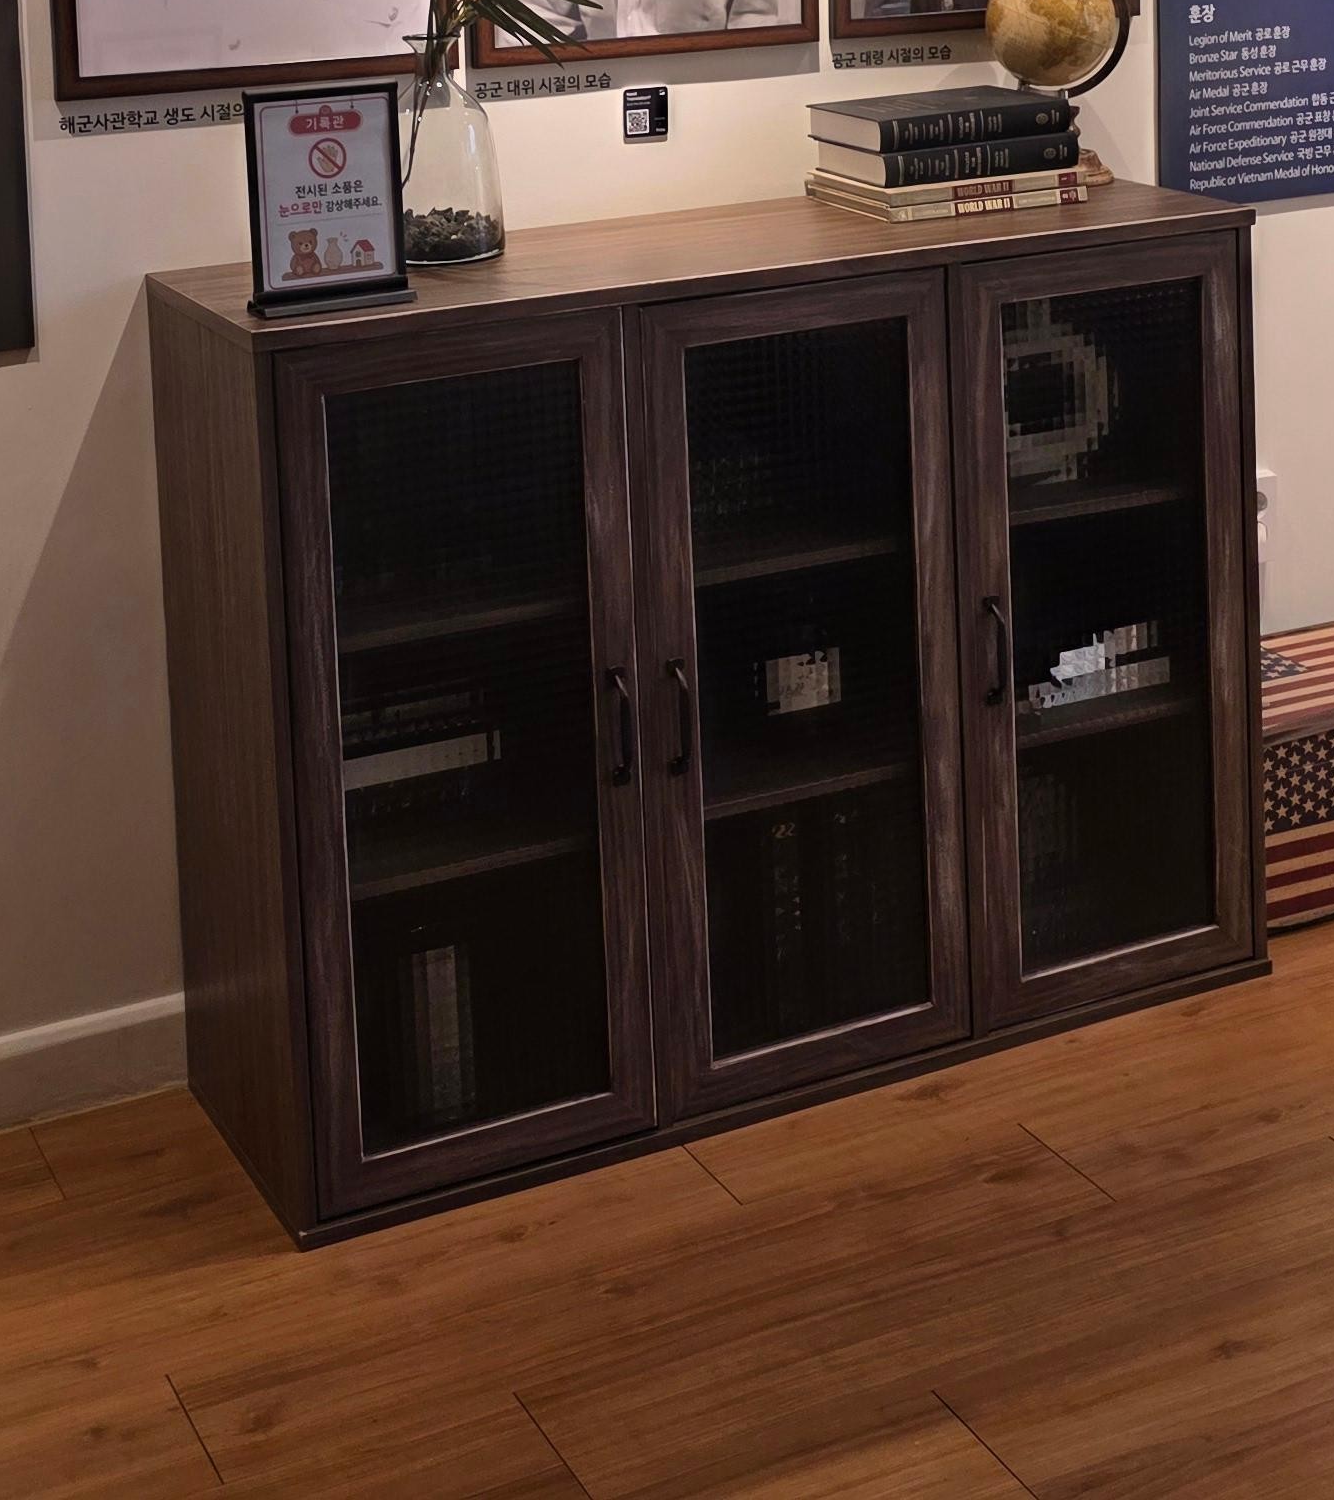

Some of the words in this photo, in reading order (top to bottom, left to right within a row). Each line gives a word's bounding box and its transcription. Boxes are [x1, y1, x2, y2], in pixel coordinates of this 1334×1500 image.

[1188, 4, 1216, 24] 훈장
[1188, 34, 1219, 49] Legion
[1218, 31, 1229, 44] of
[1229, 29, 1253, 42] Merit
[832, 52, 857, 69] 공군
[860, 49, 884, 66] 대령
[888, 46, 925, 64] 시절의
[928, 45, 953, 60] 모습
[1189, 49, 1220, 65] Bronze
[1220, 50, 1238, 62] Star
[1189, 65, 1239, 83] Meritorious
[1239, 64, 1272, 78] Service
[474, 81, 503, 99] 공군
[507, 77, 535, 96] 대위
[538, 74, 580, 93] 시절의
[583, 72, 612, 89] 모습
[1189, 86, 1202, 101] Air
[1202, 84, 1230, 99] Medal
[59, 110, 160, 134] 해군사관학교
[163, 107, 196, 126] 생도
[306, 115, 344, 131] 기록관
[295, 183, 328, 199] 전시된
[330, 179, 364, 194] 소품은
[957, 184, 982, 197] WORLD
[984, 182, 1002, 194] WAR
[278, 200, 323, 218] 눈으로만
[325, 196, 382, 213] 감상해주세요.
[957, 200, 984, 213] WORLD
[984, 198, 1003, 210] WAR
[1003, 197, 1011, 209] II
